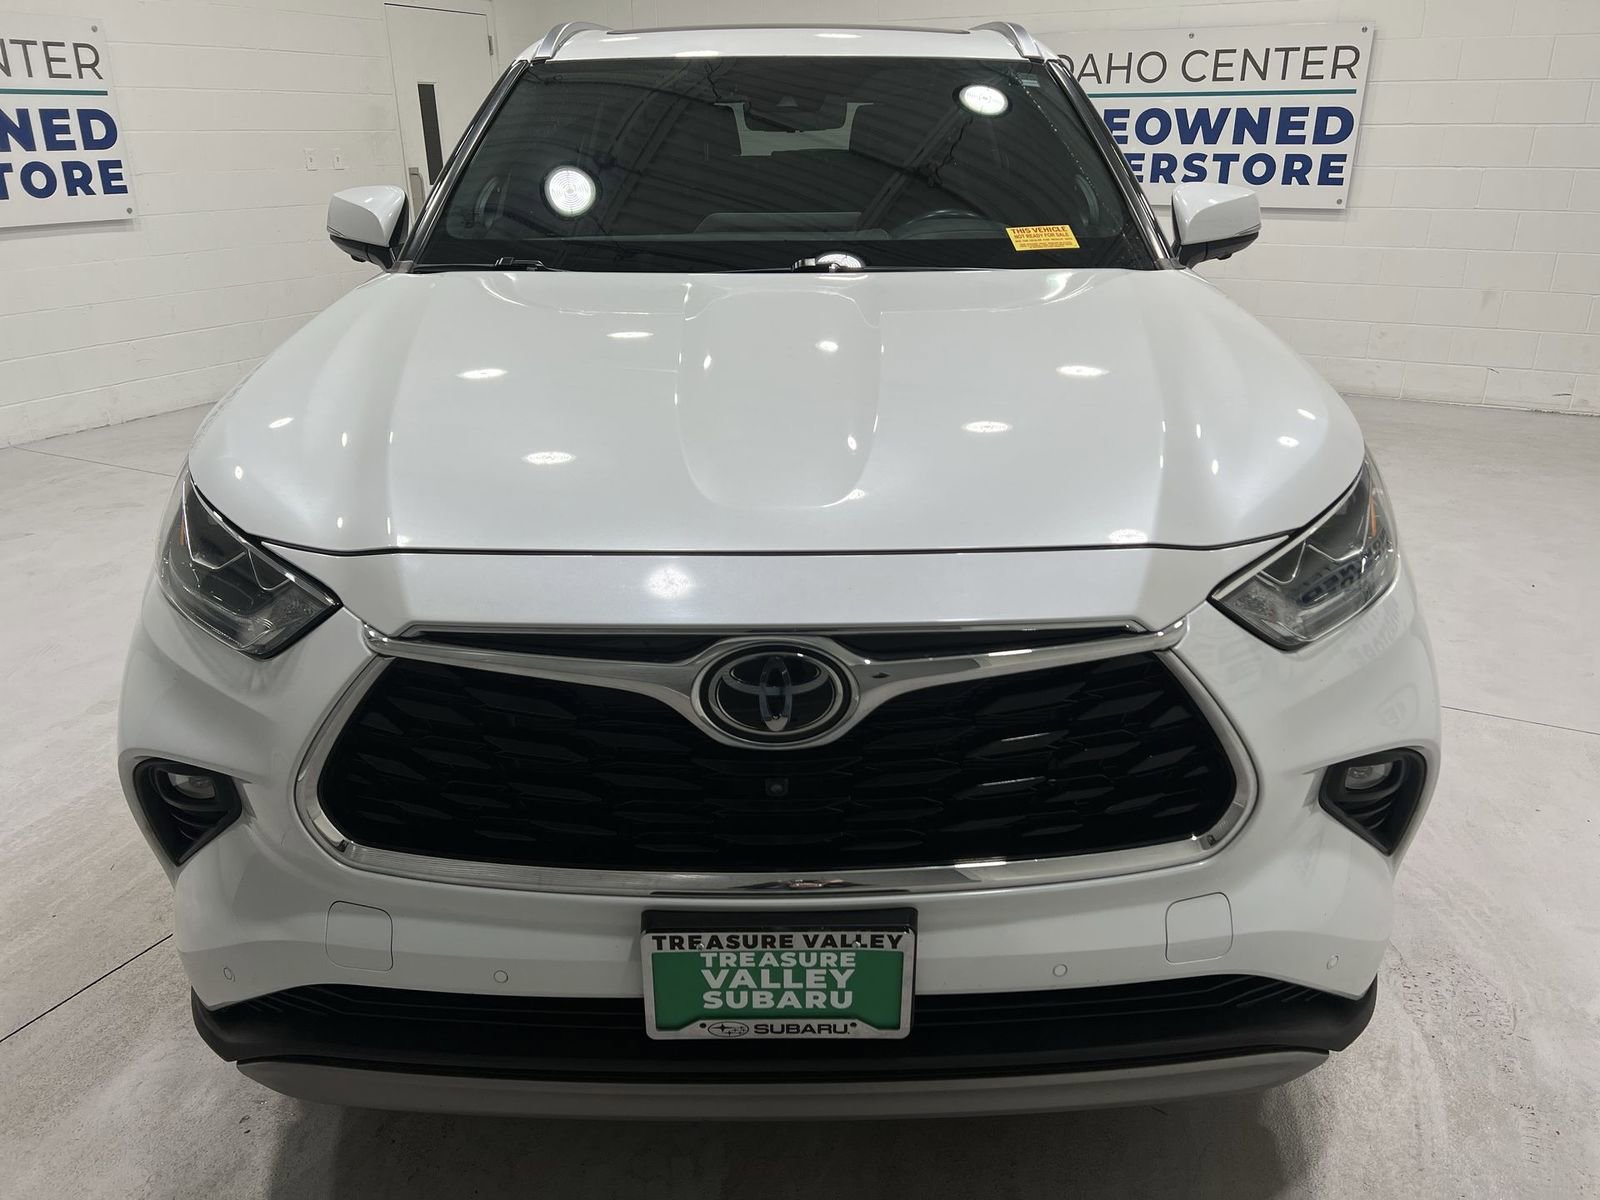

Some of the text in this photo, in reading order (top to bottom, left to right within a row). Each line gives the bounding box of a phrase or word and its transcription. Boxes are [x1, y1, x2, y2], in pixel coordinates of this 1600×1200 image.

[1181, 45, 1361, 83] CENTER
[651, 933, 904, 951] TREASURE VALLEY
[700, 951, 857, 968] TREASURE
[700, 968, 856, 989] VALLEY
[702, 990, 853, 1009] SUBARU
[753, 1023, 848, 1035] SUBARU
